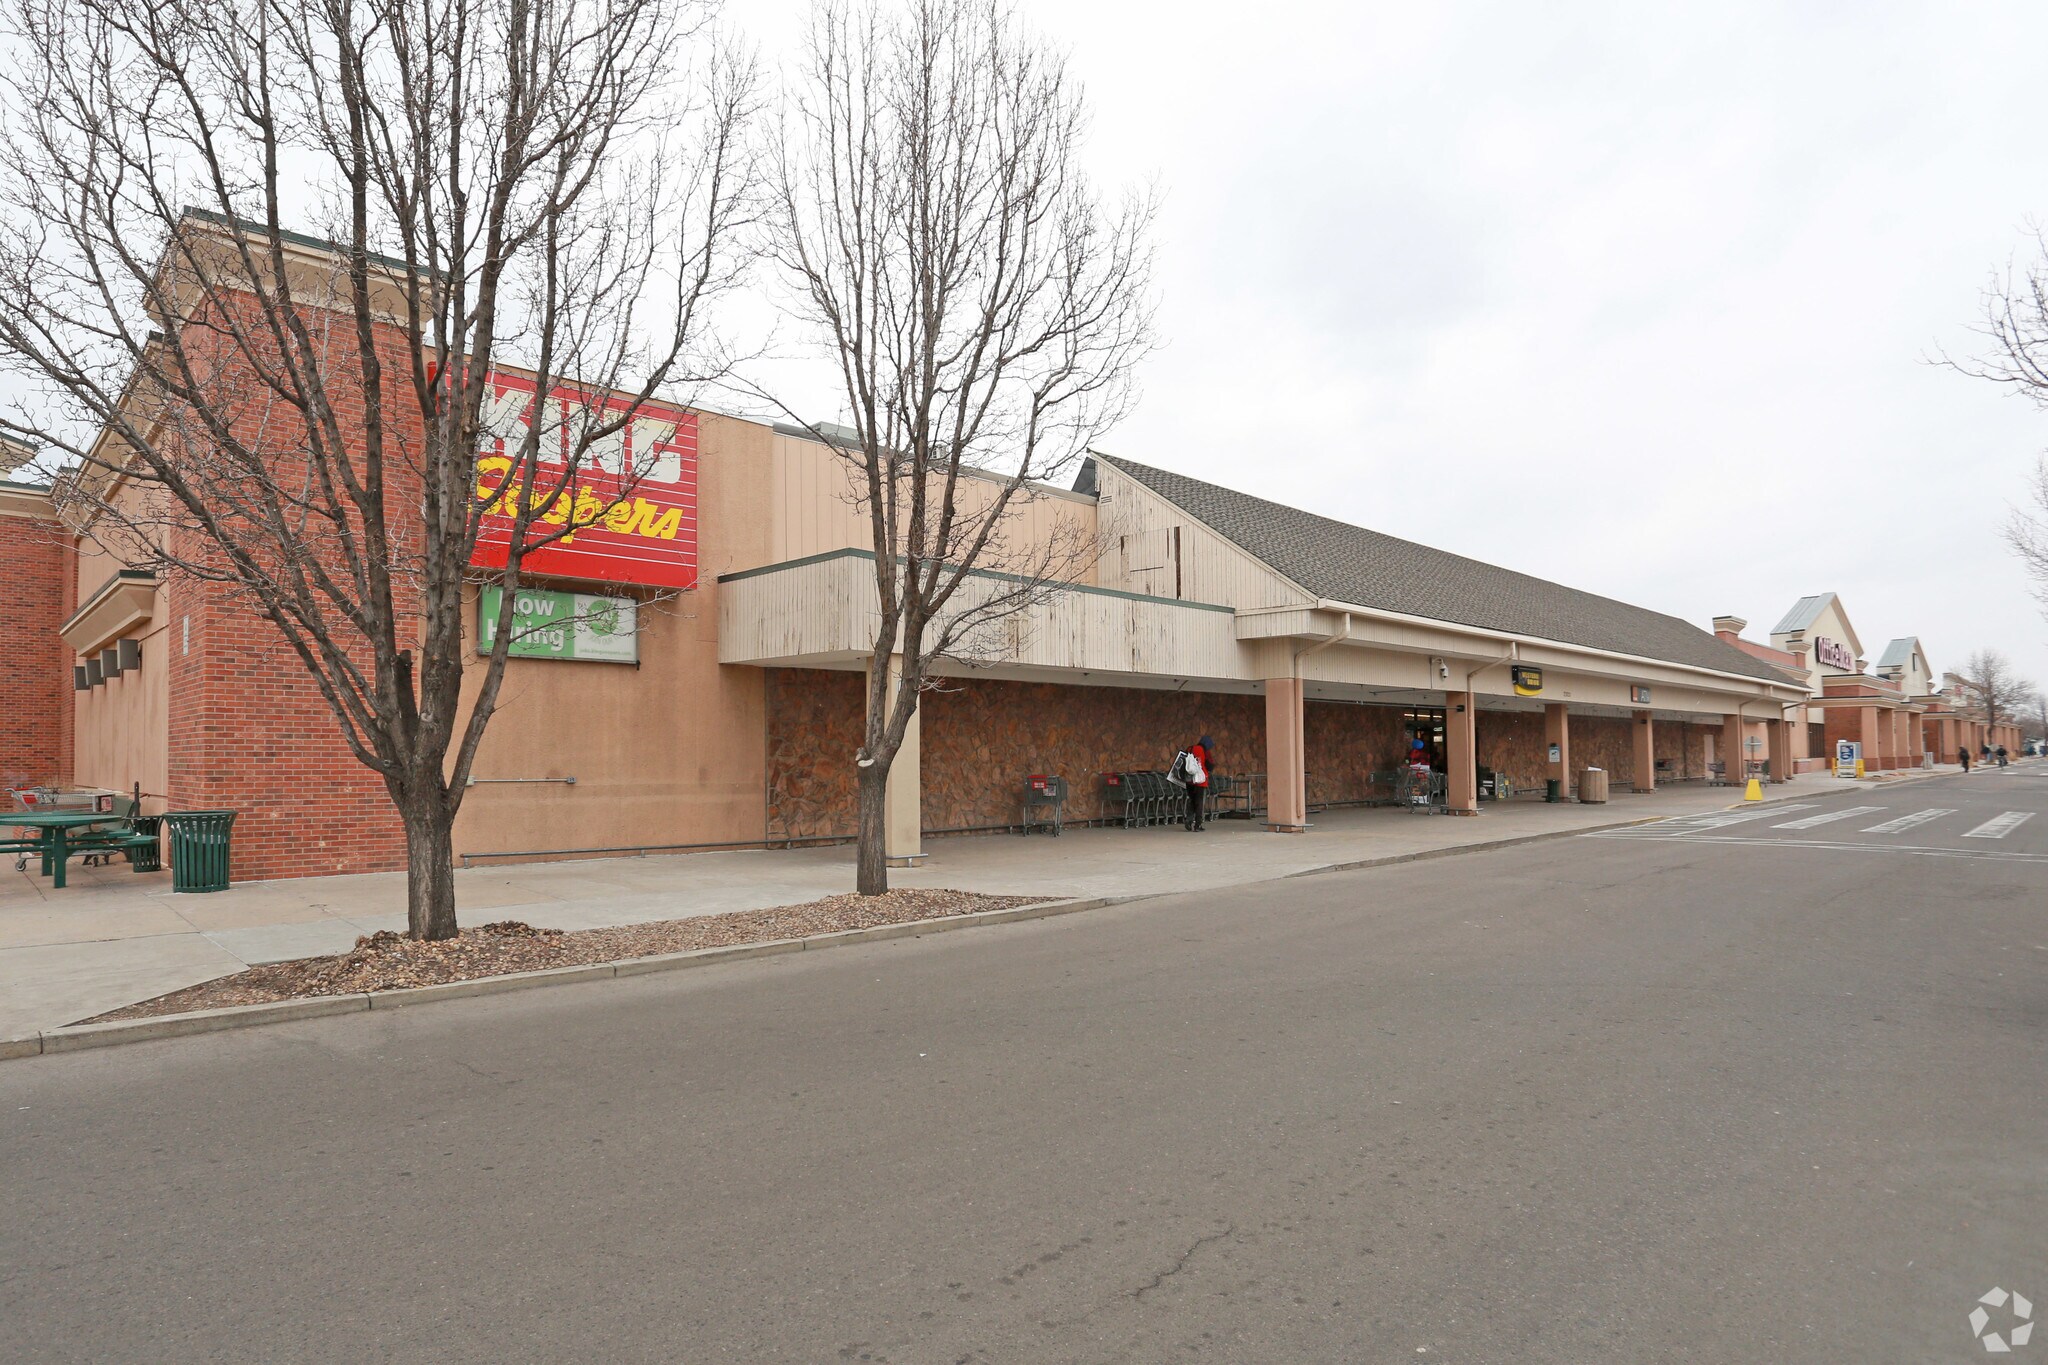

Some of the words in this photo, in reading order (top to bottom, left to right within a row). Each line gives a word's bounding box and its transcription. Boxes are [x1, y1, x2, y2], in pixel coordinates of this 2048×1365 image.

[479, 384, 681, 484] KING
[499, 590, 555, 616] ow
[487, 618, 565, 652] Hring
